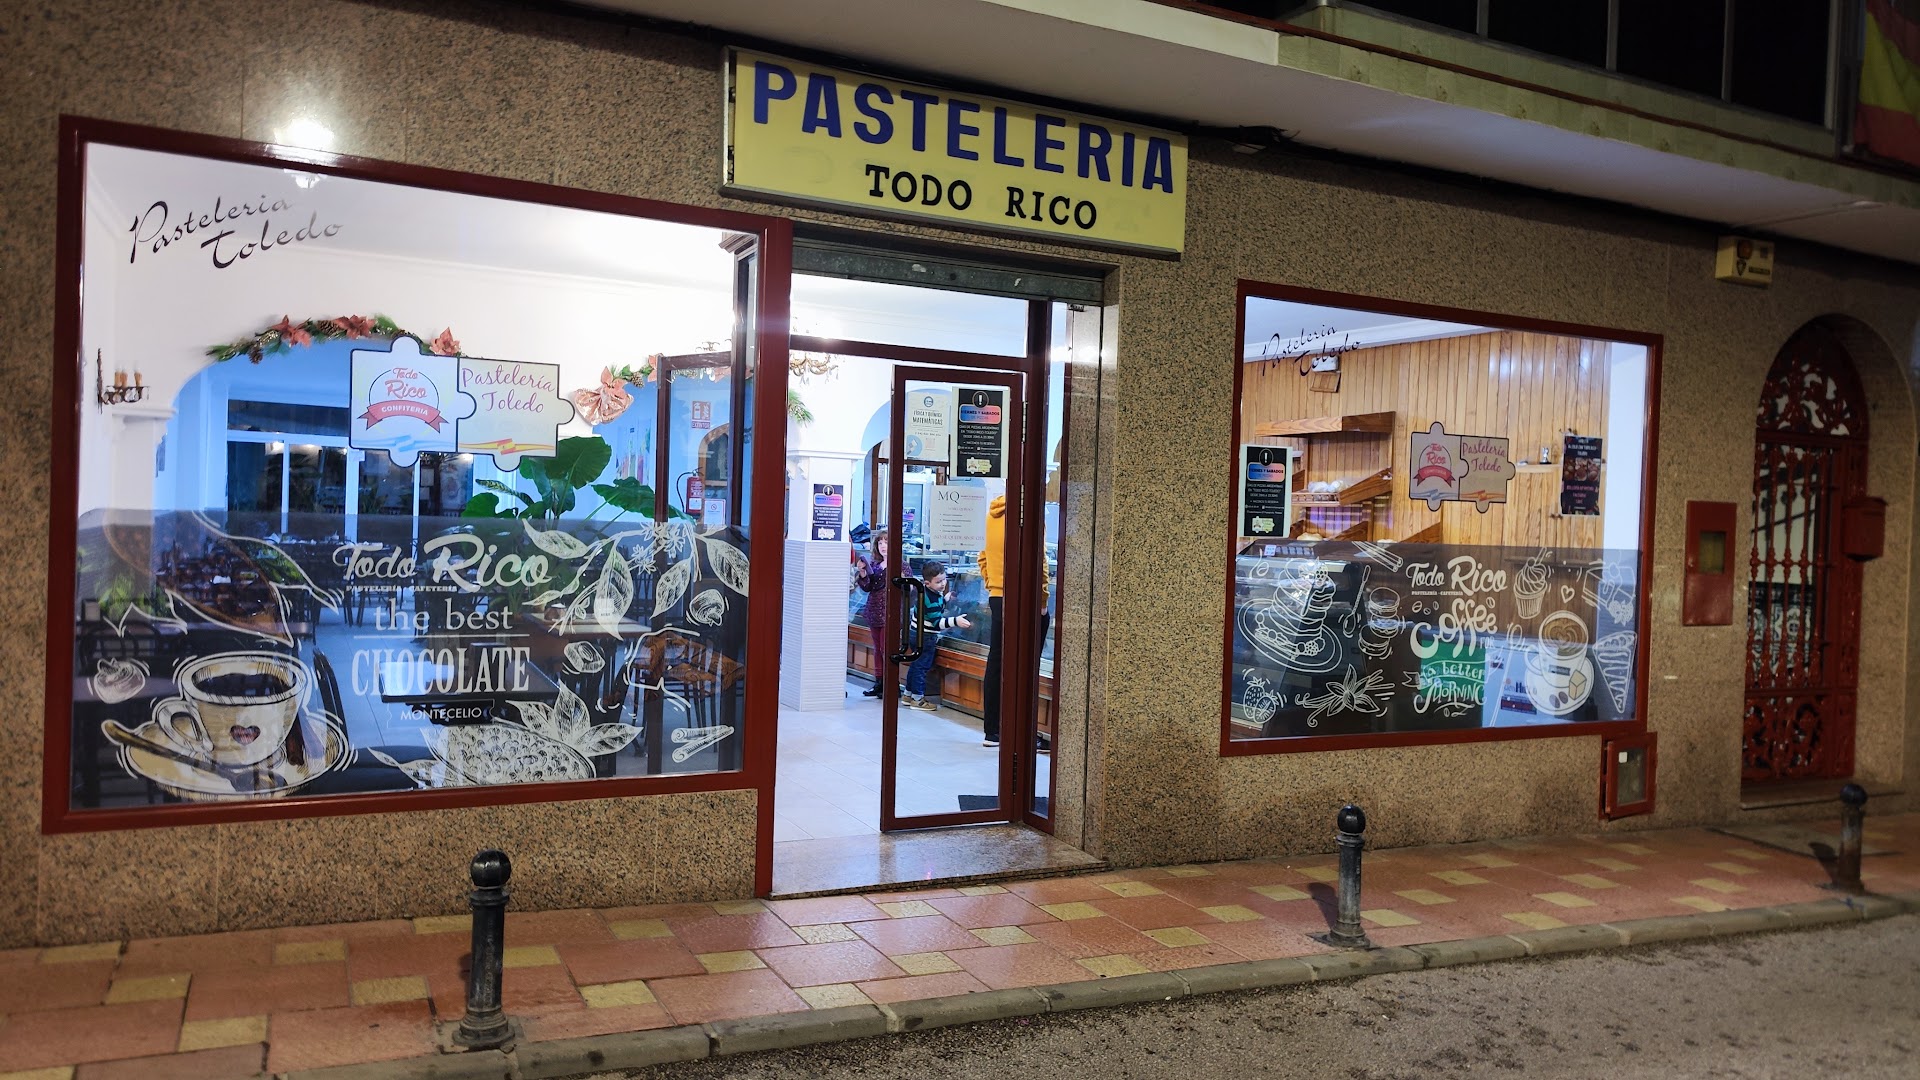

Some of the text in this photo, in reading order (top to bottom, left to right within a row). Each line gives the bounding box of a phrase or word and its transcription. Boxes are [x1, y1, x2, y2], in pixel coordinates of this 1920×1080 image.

[753, 60, 1174, 194] PASTELERIA
[865, 164, 1098, 230] TODO RICO
[129, 195, 293, 264] Pasteleria
[201, 209, 344, 269] Toledo
[1294, 333, 1361, 377] Toledo
[384, 379, 428, 399] Rico
[392, 367, 418, 380] Todo
[461, 364, 555, 393] Pastelería
[381, 404, 429, 416] CONFITERIA
[481, 389, 545, 415] Toledo
[1471, 456, 1502, 472] Toledo
[332, 533, 553, 593] Todo Rico
[1405, 555, 1508, 597] Todo Rico
[374, 597, 514, 631] the best
[1410, 597, 1498, 660] Coffee
[1480, 637, 1495, 649] FOR
[352, 647, 531, 697] CHOCOLATE
[1441, 661, 1485, 680] better
[400, 706, 483, 721] MONTECELIO
